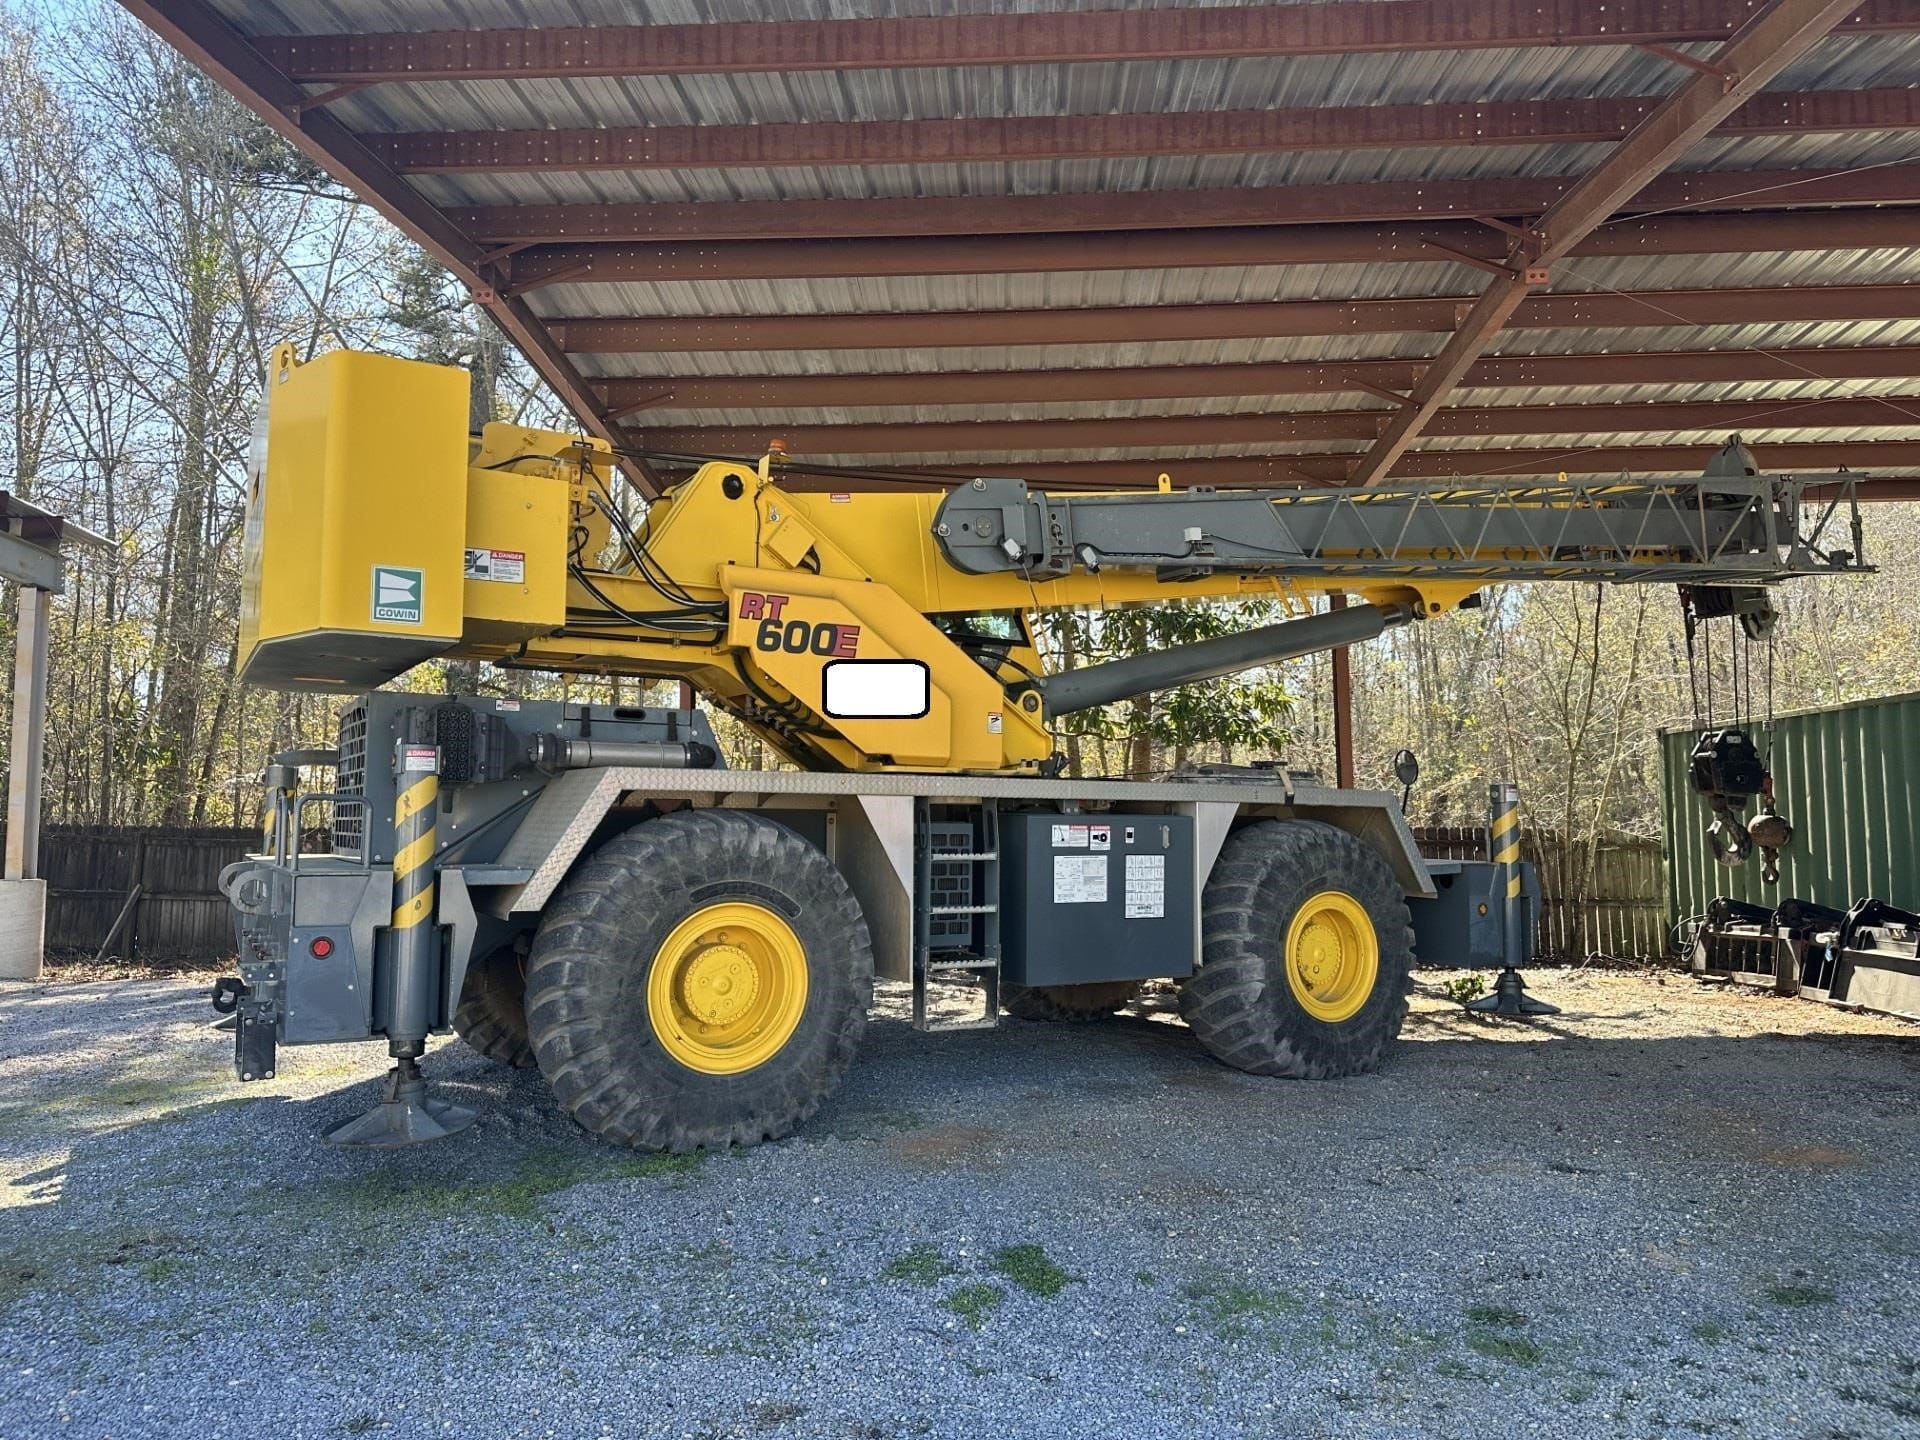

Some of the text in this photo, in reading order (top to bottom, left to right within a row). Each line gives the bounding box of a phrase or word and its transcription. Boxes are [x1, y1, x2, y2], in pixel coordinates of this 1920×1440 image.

[498, 552, 523, 560] DANGER
[378, 608, 416, 618] COWIN
[739, 592, 789, 620] RT
[757, 618, 860, 658] 600E
